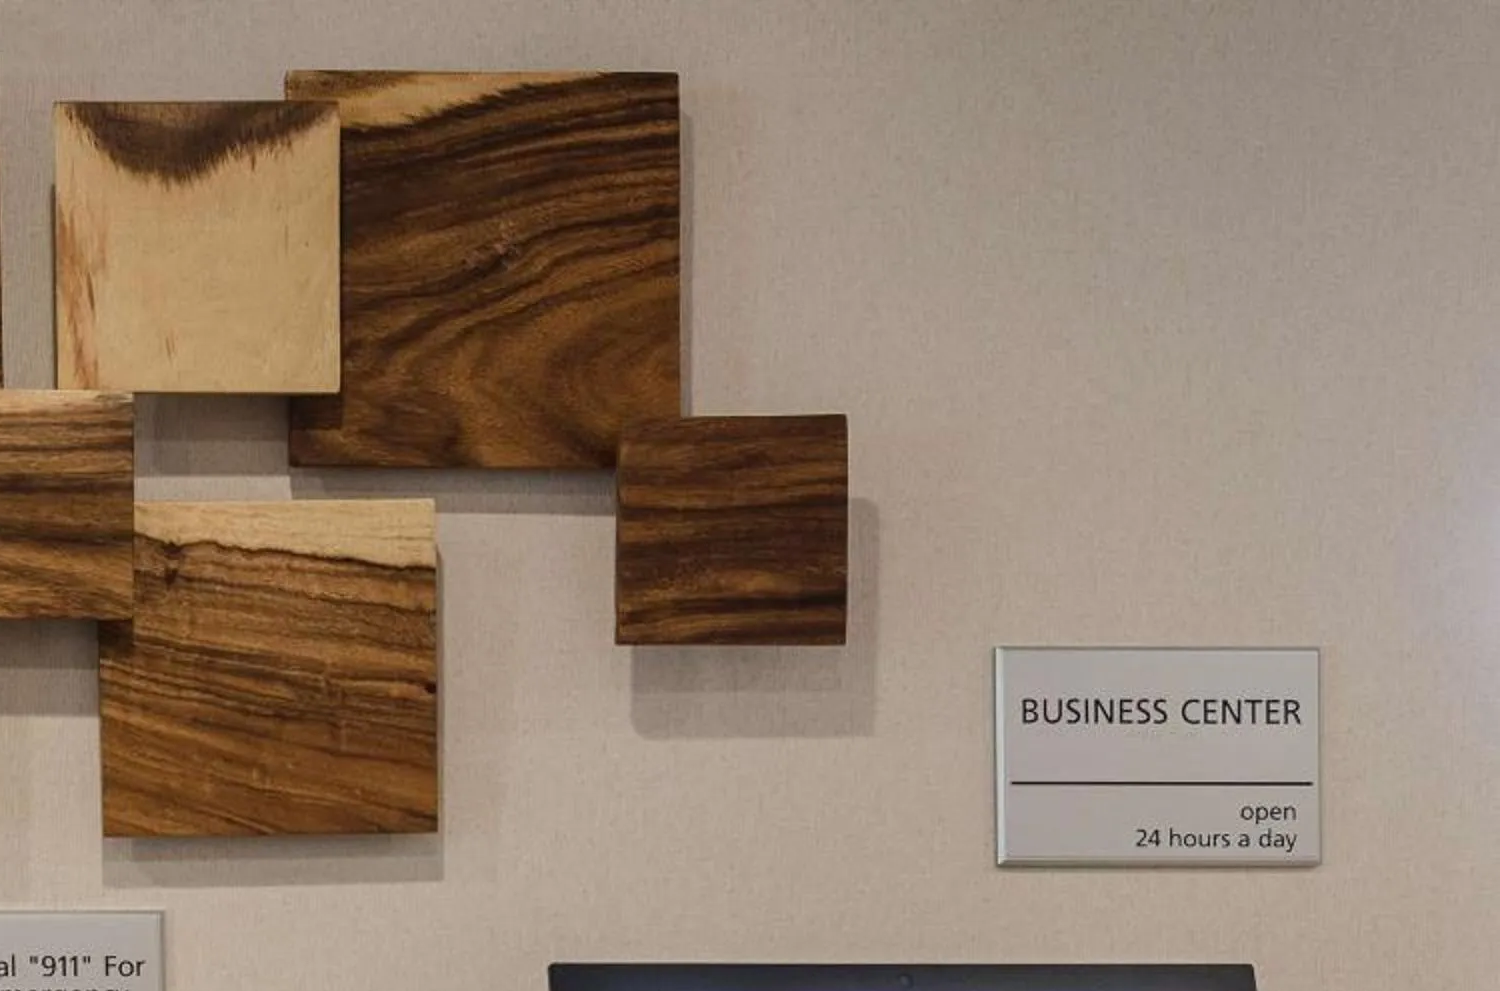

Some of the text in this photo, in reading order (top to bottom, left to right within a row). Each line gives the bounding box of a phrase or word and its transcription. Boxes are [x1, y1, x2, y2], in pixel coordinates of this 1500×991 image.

[1021, 698, 1301, 725] BUSINESS CENTER
[1240, 804, 1297, 824] open
[1135, 828, 1298, 852] 24 hours a day
[29, 955, 92, 977] "911"
[104, 955, 147, 977] For
